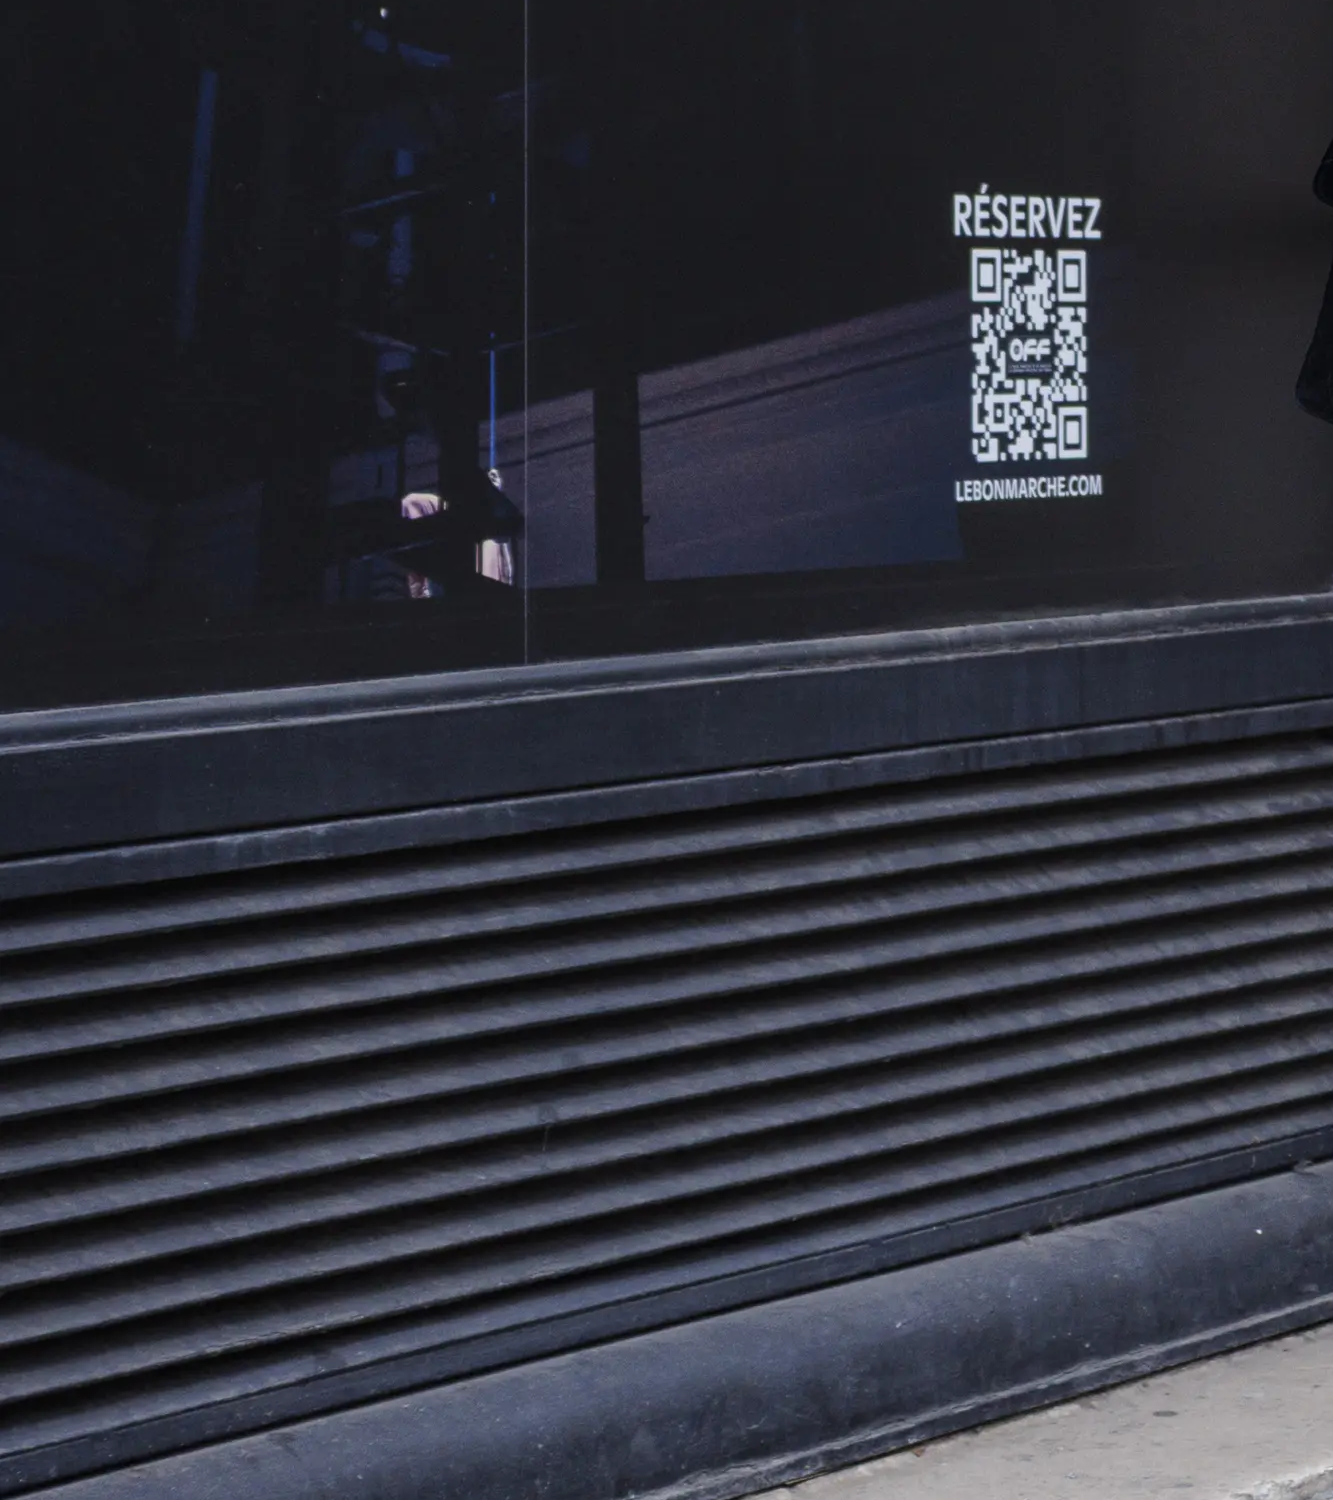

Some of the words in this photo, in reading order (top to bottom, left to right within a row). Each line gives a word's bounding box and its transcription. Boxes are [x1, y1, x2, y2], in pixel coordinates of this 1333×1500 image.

[953, 182, 1102, 239] RÉSERVEZ
[1009, 337, 1052, 362] OFF
[955, 474, 1104, 503] LEBONMARCHE.COM
